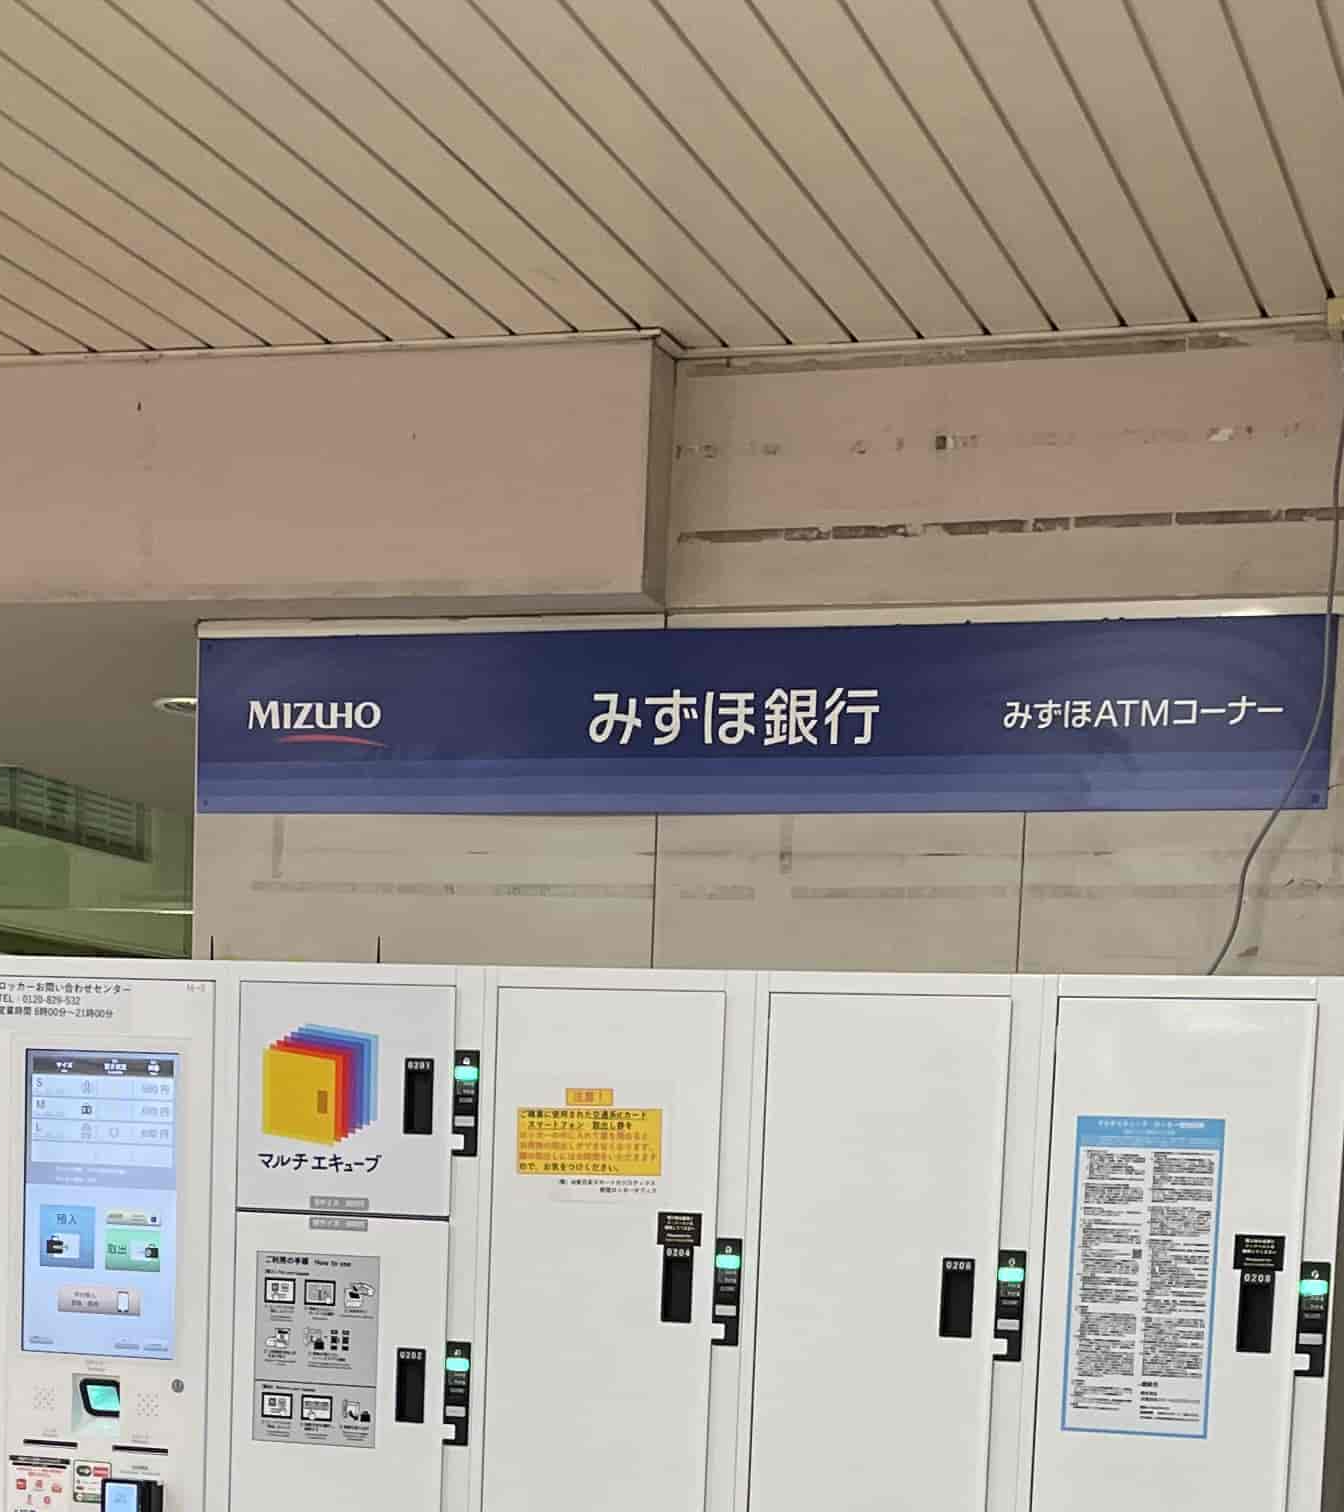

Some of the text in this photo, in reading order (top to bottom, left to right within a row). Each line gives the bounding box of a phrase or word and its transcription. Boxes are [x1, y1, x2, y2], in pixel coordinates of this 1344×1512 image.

[247, 699, 383, 730] MIZUHO
[587, 687, 881, 747] みずほ銀行
[1003, 695, 1284, 729] みずほATMコーナー
